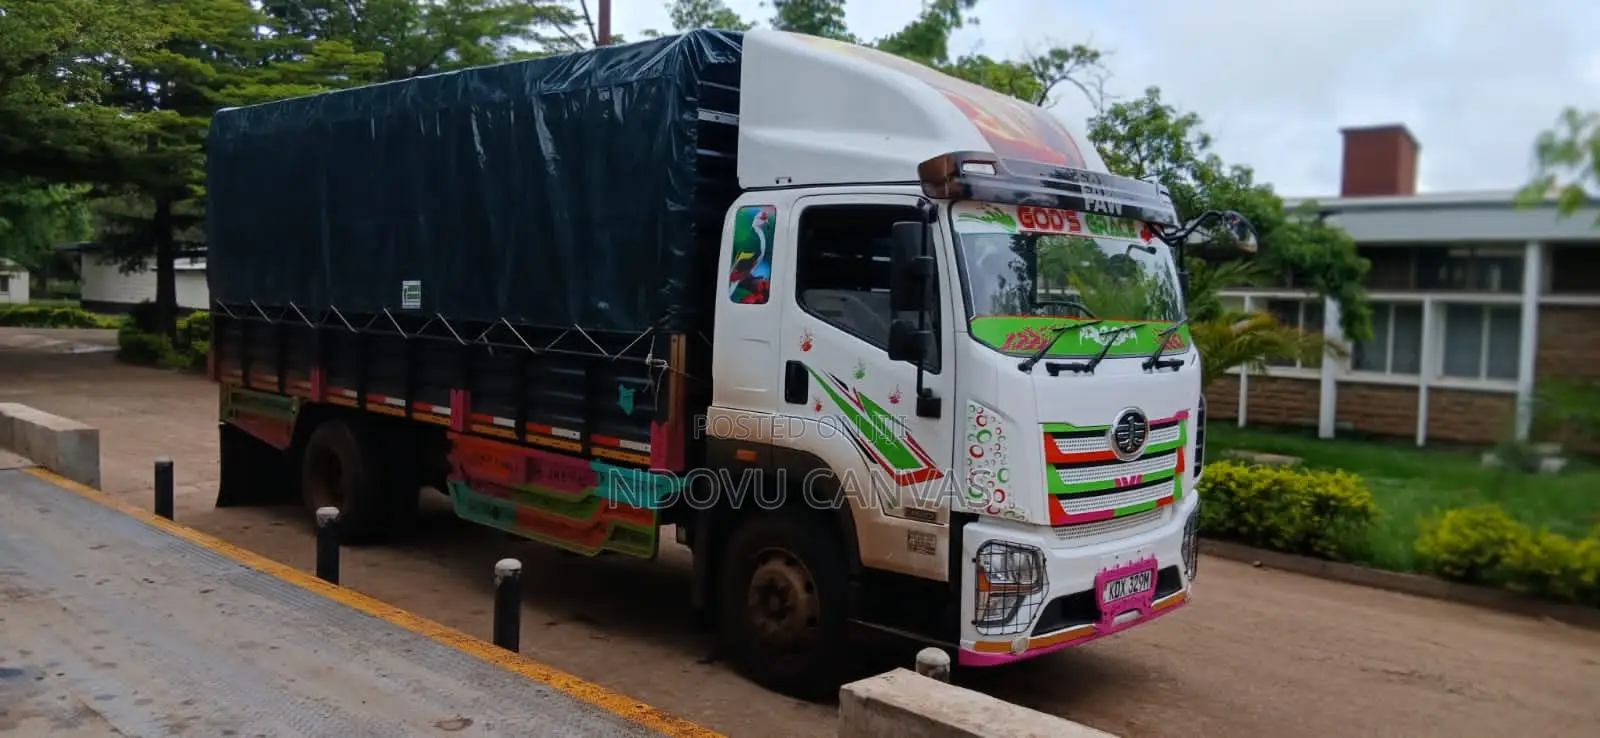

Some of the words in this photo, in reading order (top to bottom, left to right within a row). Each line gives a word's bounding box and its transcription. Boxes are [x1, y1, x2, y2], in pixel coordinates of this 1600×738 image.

[1083, 197, 1122, 216] FAW
[1017, 206, 1081, 233] GOD'S
[1109, 579, 1126, 600] KDX
